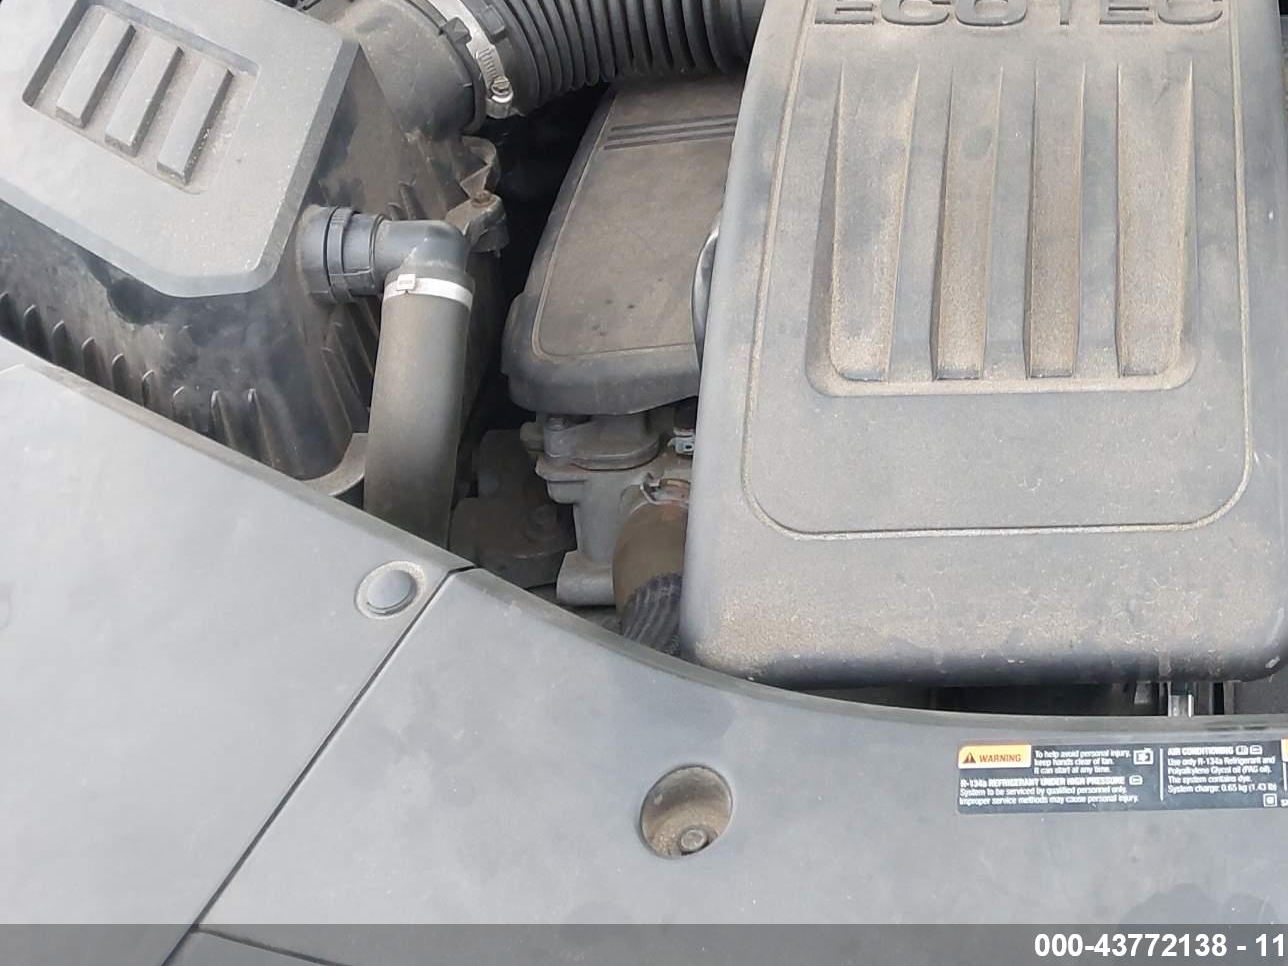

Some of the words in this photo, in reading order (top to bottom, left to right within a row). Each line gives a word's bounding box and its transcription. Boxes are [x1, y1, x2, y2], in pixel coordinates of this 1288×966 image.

[1035, 750, 1043, 758] To
[1044, 750, 1059, 759] help
[1061, 750, 1079, 758] avoid
[1080, 749, 1109, 758] personal
[1168, 747, 1181, 755] AIR
[1182, 746, 1234, 755] CONDITIONING
[979, 754, 1021, 763] WARNING
[1035, 759, 1052, 767] keep
[1053, 758, 1072, 766] hands
[1093, 757, 1100, 765] of
[1168, 758, 1181, 766] Use
[1182, 757, 1196, 766] only
[1198, 757, 1223, 765] R-134a
[1224, 756, 1261, 766] Refrigerant
[1262, 756, 1275, 764] and
[1211, 766, 1231, 775] Glycol
[960, 779, 987, 787] R-134a
[989, 778, 1039, 787] REFRIGERANT
[1041, 778, 1066, 786] UNDER
[1067, 777, 1085, 786] HIGH
[1087, 776, 1125, 786] PRESSURE
[1182, 776, 1207, 784] system
[960, 789, 986, 798] System
[996, 788, 1004, 796] be
[1006, 788, 1035, 796] serviced
[1036, 788, 1045, 796] by
[1046, 787, 1075, 796] qualified
[1077, 787, 1110, 795] personnel
[1168, 785, 1193, 794] System
[960, 798, 990, 807] Improper
[1019, 796, 1048, 805] methods
[1049, 797, 1064, 806] may
[1087, 796, 1117, 804] personal
